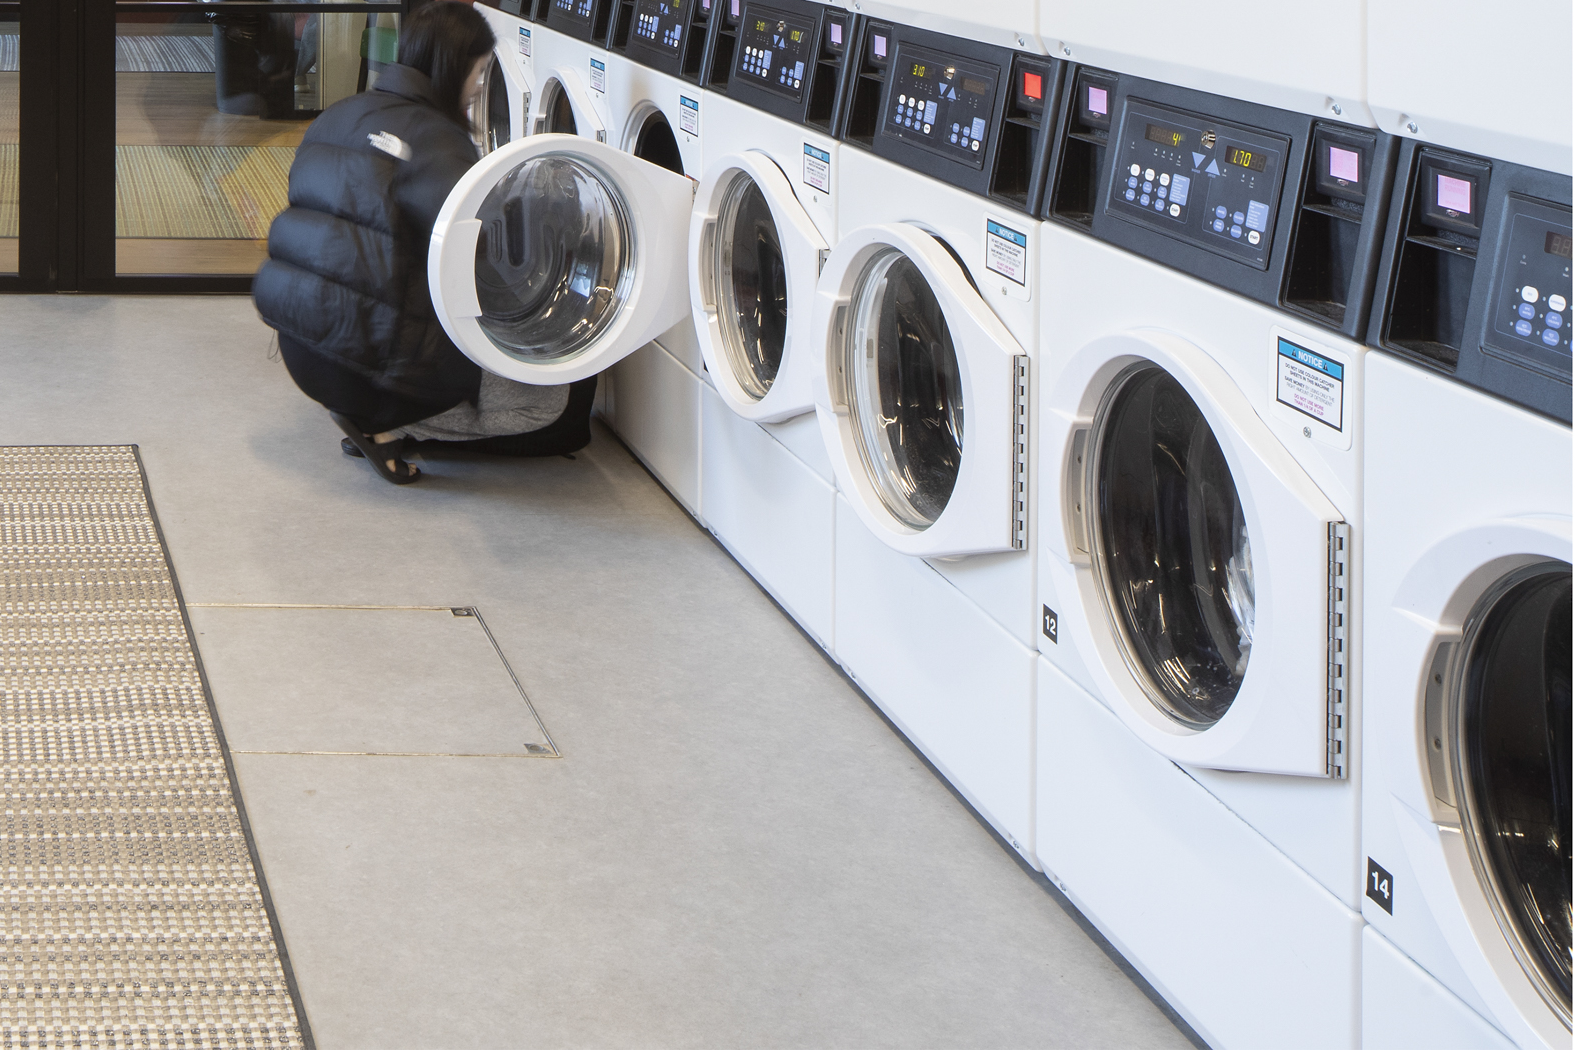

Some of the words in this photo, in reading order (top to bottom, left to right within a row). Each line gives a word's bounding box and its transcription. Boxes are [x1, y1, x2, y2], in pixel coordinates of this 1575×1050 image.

[1000, 228, 1014, 240] NOTICE
[1298, 350, 1323, 369] NOTICE
[1305, 372, 1318, 382] COLOUR
[1045, 615, 1056, 635] 12
[1372, 871, 1390, 899] 14
